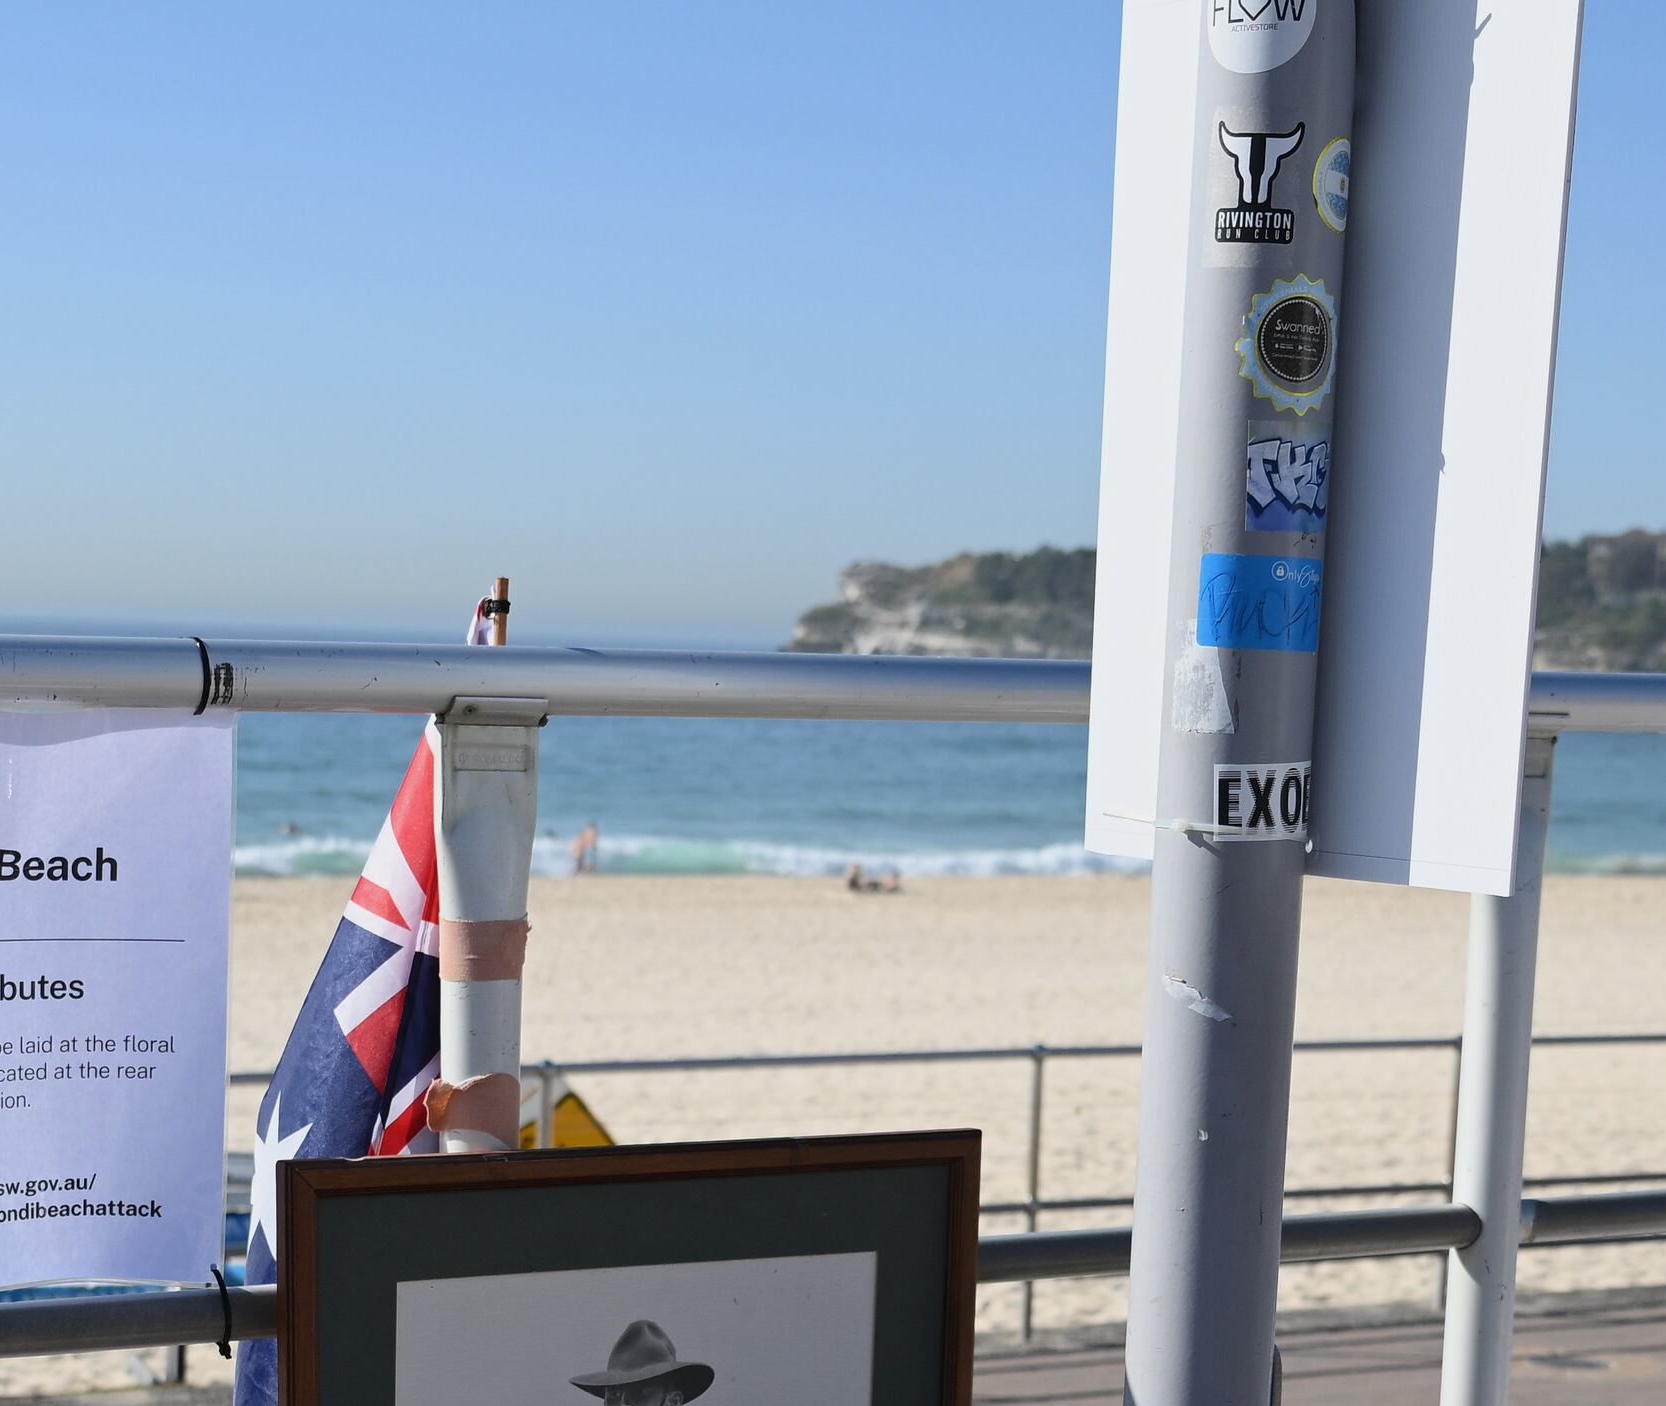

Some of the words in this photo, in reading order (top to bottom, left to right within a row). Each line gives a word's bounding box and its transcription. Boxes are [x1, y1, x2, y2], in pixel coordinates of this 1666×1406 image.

[1231, 23, 1280, 33] ACTIVESTORE
[1218, 211, 1292, 230] RIVINGTON
[1217, 228, 1241, 239] RUN
[1254, 229, 1290, 240] CLUB
[20, 1035, 52, 1054] laid
[60, 1036, 78, 1053] at
[85, 1035, 116, 1052] the
[123, 1035, 175, 1053] floral
[54, 1062, 72, 1079] at
[79, 1062, 110, 1079] the
[117, 1065, 156, 1079] rear
